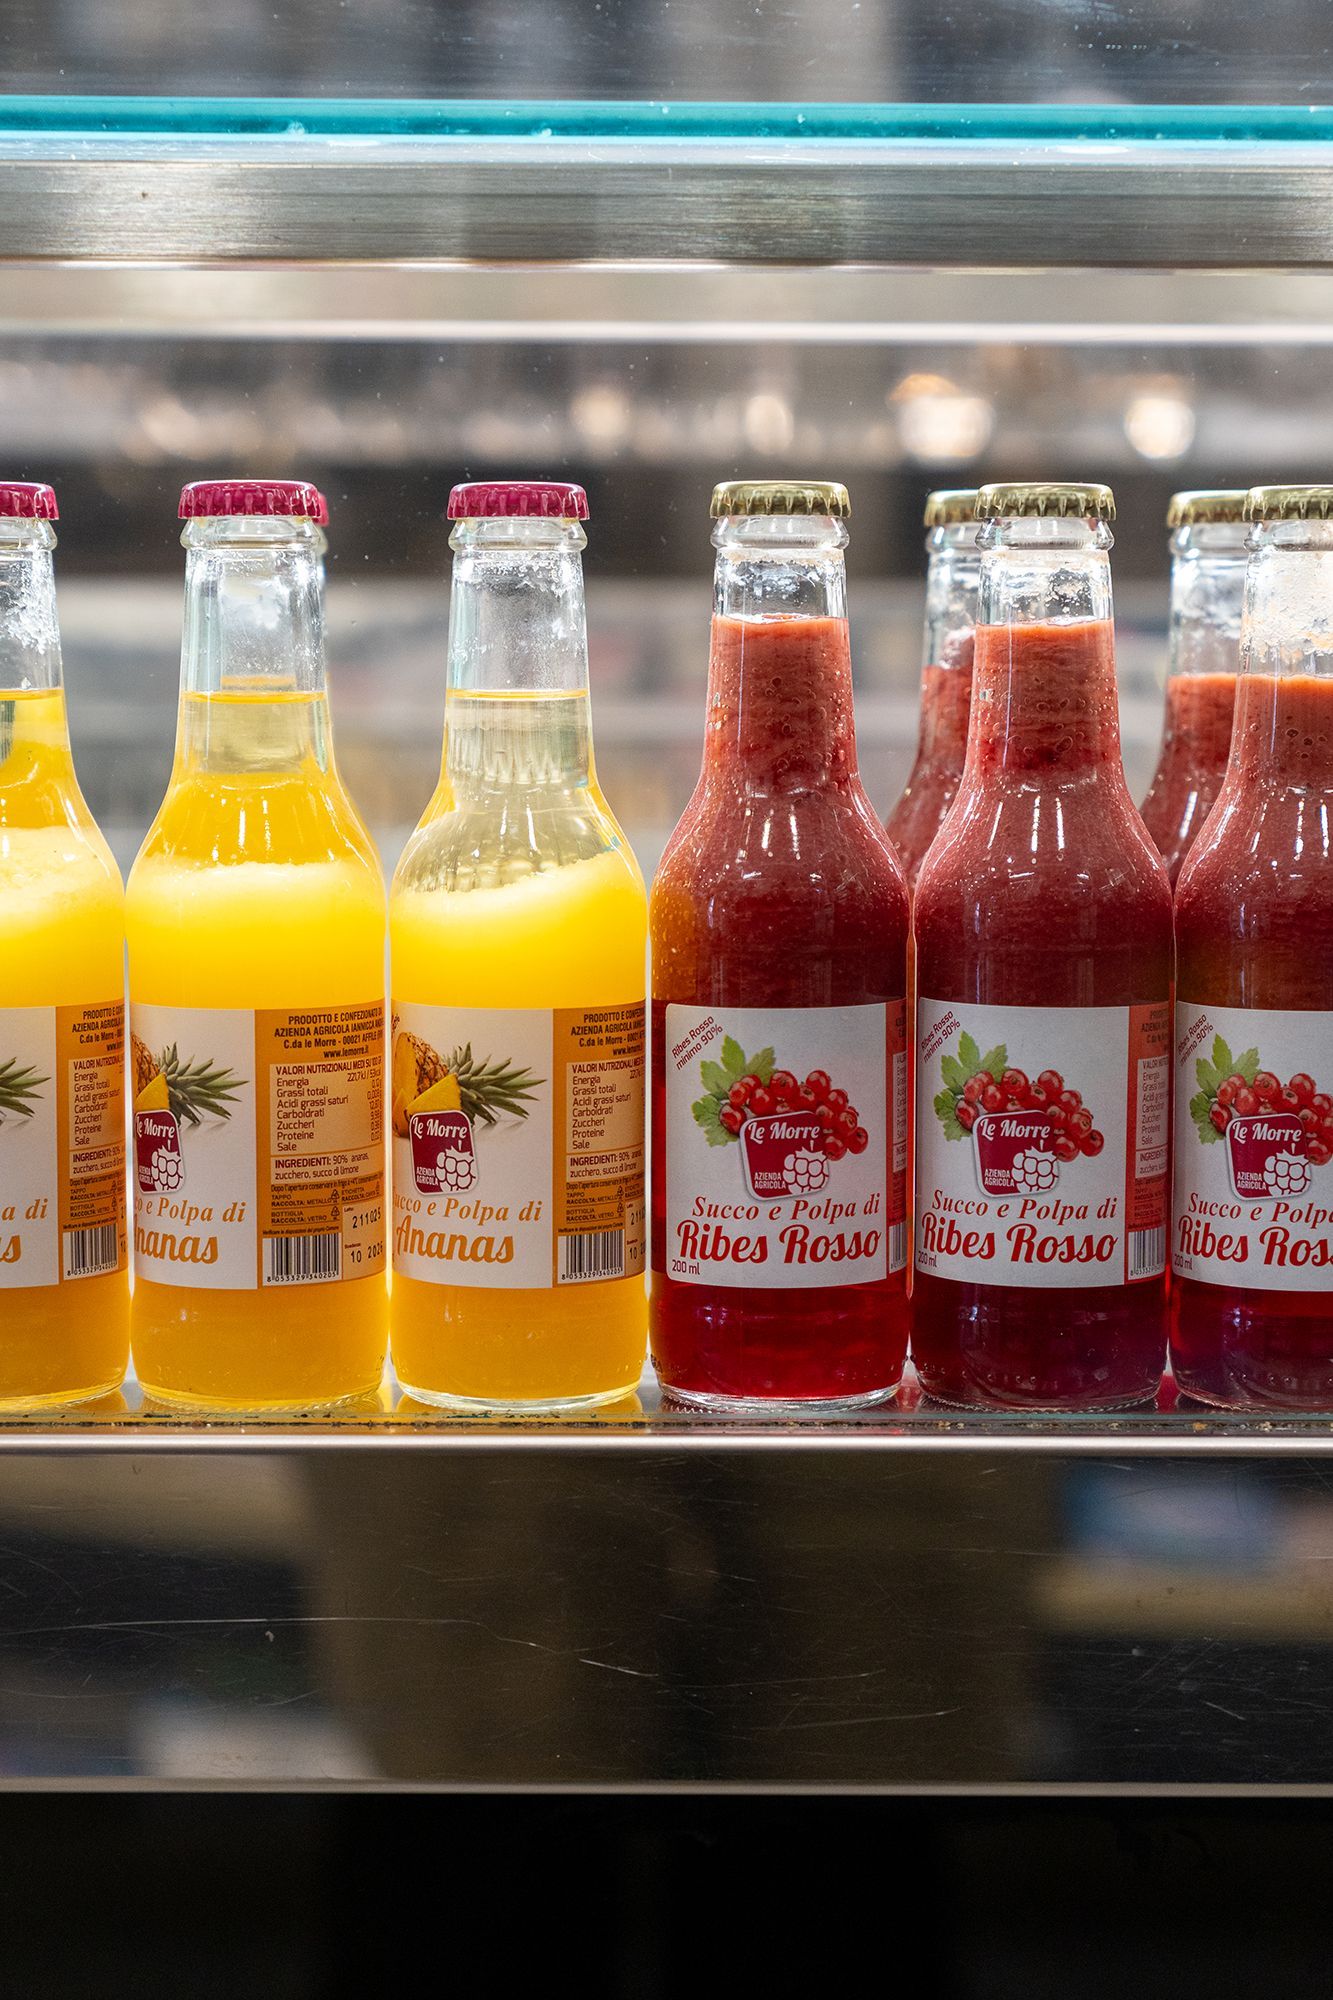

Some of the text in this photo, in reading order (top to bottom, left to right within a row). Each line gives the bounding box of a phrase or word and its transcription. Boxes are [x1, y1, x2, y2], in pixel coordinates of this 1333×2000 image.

[289, 1013, 338, 1024] PRODOTTO E
[584, 1012, 619, 1023] PRODOTTO
[932, 1011, 953, 1034] Rosso
[72, 1021, 99, 1033] AZIENDA
[275, 1024, 350, 1037] AZIENDA AGRICOLA
[571, 1025, 602, 1035] AZIENDA
[605, 1021, 632, 1033] AGRICOLA
[941, 1019, 960, 1040] 90%
[1188, 1014, 1207, 1037] Rosso
[671, 1016, 715, 1059] Ribes Rosso
[1196, 1022, 1214, 1043] 90%
[284, 1039, 302, 1049] C.da
[305, 1038, 312, 1048] le
[315, 1037, 336, 1047] Morre
[579, 1038, 595, 1047] C.da
[605, 1035, 622, 1045] Morre
[676, 1024, 723, 1071] minimo 90%
[73, 1060, 95, 1070] VALORI
[276, 1065, 305, 1075] VALORI
[307, 1061, 352, 1074] NUTRIZIONALI
[572, 1063, 598, 1073] VALORI
[74, 1070, 98, 1082] Energia
[573, 1076, 600, 1086] Energia
[74, 1081, 95, 1092] Grassi
[277, 1077, 309, 1088] Energia
[277, 1086, 328, 1097] Grassi totali
[573, 1084, 616, 1096] Grassi totali
[74, 1093, 91, 1103] Acidi
[277, 1095, 348, 1110] Acidi grassi saturi
[573, 1097, 591, 1106] Acidi
[593, 1095, 614, 1108] grassi
[277, 1108, 325, 1119] Carboidrati
[572, 1106, 613, 1117] Carboidrati
[75, 1113, 102, 1124] Zuccheri
[572, 1117, 605, 1128] Zuccheri
[75, 1123, 101, 1135] Proteine
[144, 1118, 175, 1138] Morre
[277, 1120, 314, 1130] Zuccheri
[412, 1116, 468, 1139] Le Morre
[980, 1118, 1050, 1141] Le Morre
[277, 1131, 314, 1140] Proteine
[573, 1129, 605, 1139] Proteine
[748, 1121, 820, 1144] Le Morre
[1232, 1121, 1302, 1144] Le Morre
[75, 1135, 90, 1146] Sale
[573, 1140, 590, 1149] Sale
[277, 1142, 297, 1152] Sale
[275, 1156, 331, 1168] INGREDIENTI:
[333, 1154, 348, 1165] 90%
[275, 1165, 359, 1180] zucchero, succo di limone
[416, 1166, 435, 1176] AZIENDA
[603, 1165, 618, 1174] succo
[984, 1168, 1010, 1178] AZIENDA
[417, 1176, 438, 1186] AGRICOLA
[754, 1172, 782, 1181] AZIENDA
[984, 1177, 1015, 1187] AGRICOLA
[1237, 1171, 1262, 1181] AZIENDA
[754, 1180, 786, 1190] AGRICOLA
[1237, 1181, 1266, 1190] AGRICOLA
[25, 1198, 48, 1219] di
[157, 1197, 214, 1226] Polpa
[222, 1201, 247, 1222] di
[427, 1201, 437, 1216] e
[444, 1197, 509, 1226] Polpa
[518, 1200, 543, 1222] di
[692, 1196, 760, 1220] Succo
[768, 1205, 781, 1221] e
[791, 1199, 861, 1225] Polpa
[863, 1192, 881, 1215] di
[932, 1189, 988, 1216] Succo
[997, 1203, 1009, 1218] e
[1018, 1198, 1088, 1226] Polpa
[1096, 1197, 1118, 1219] di
[1188, 1192, 1242, 1219] Succo
[1250, 1206, 1263, 1221] e
[396, 1214, 514, 1264] Ananas
[676, 1219, 882, 1264] Ribes Rosso
[922, 1211, 1119, 1264] Ribes Rosso
[1178, 1215, 1248, 1263] Ribes
[351, 1250, 362, 1263] 10
[629, 1247, 637, 1259] 10
[672, 1259, 700, 1275] 200 ml
